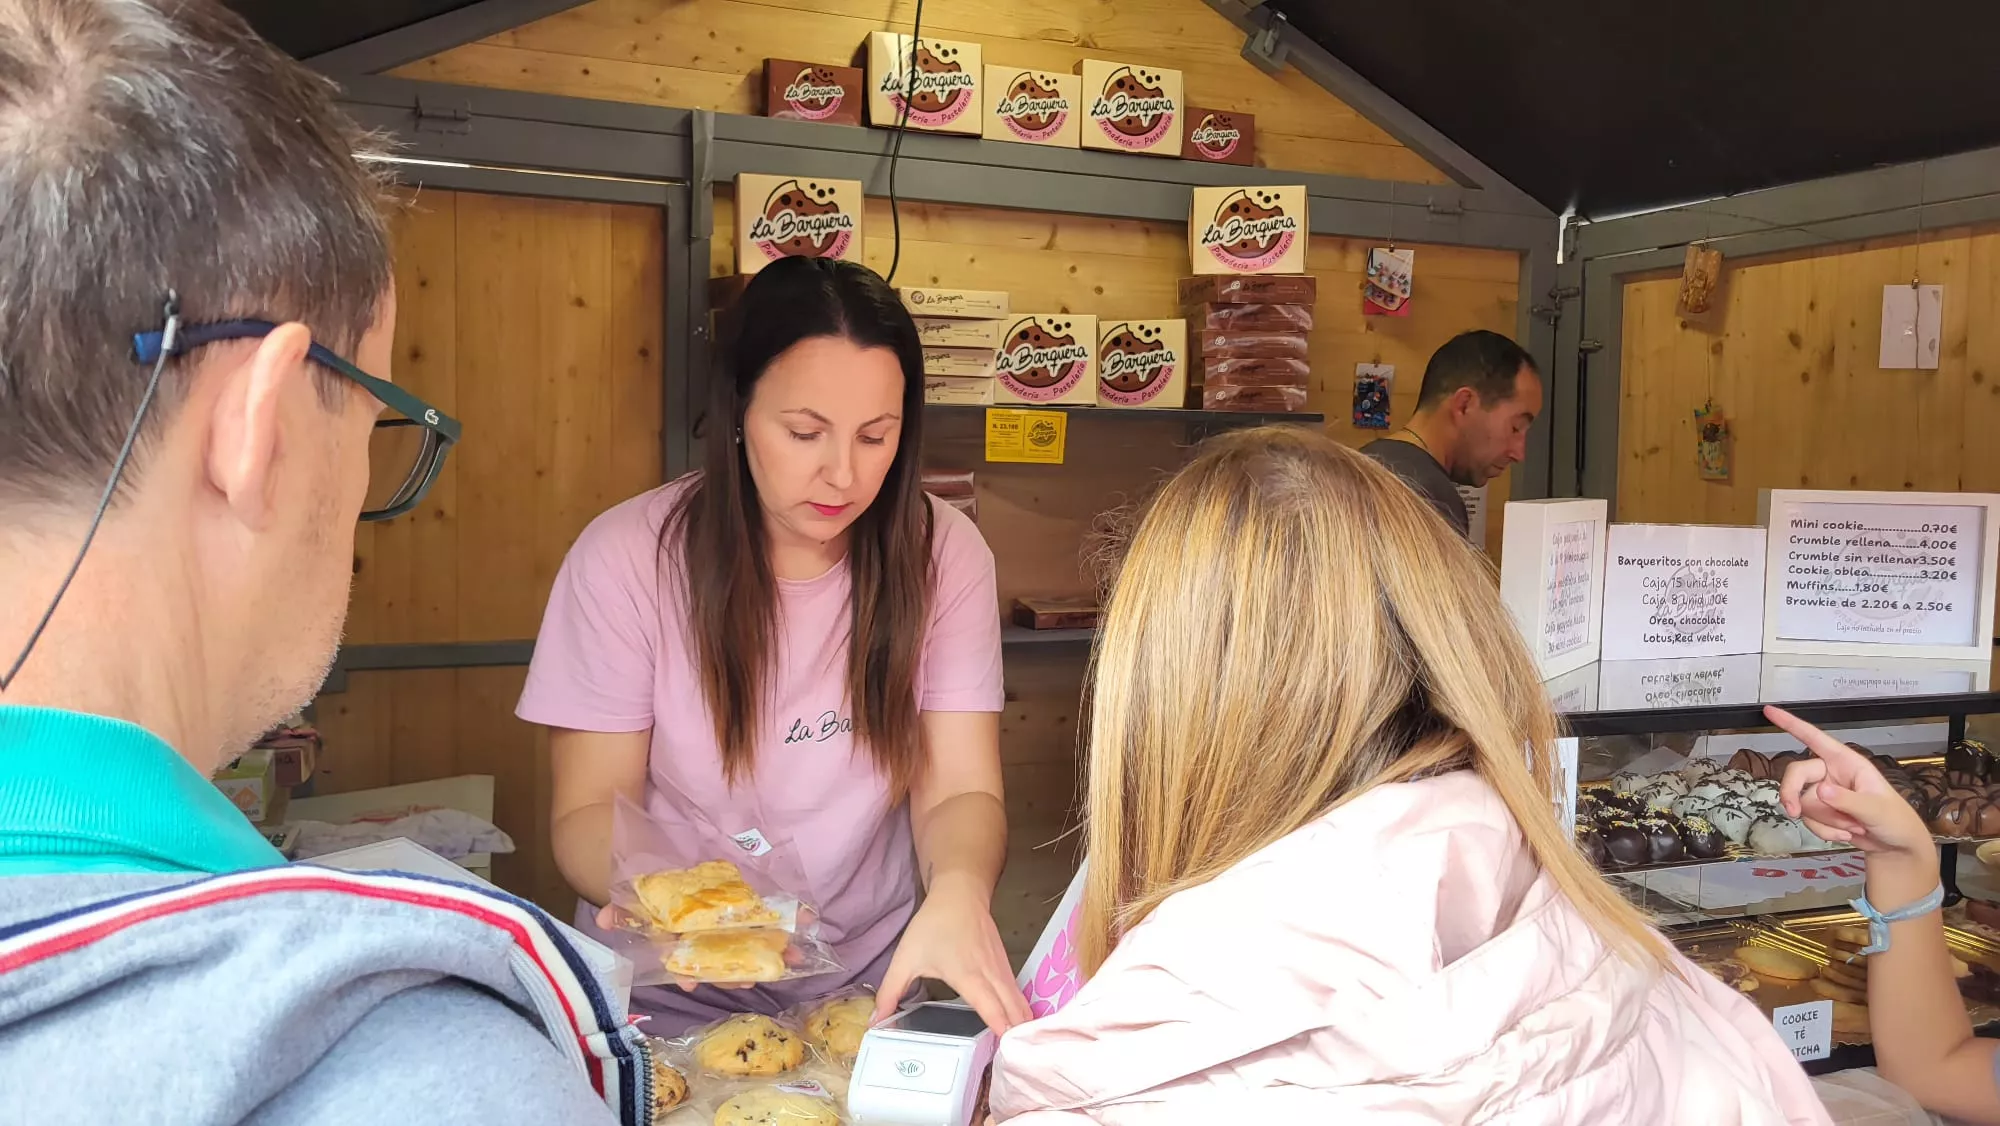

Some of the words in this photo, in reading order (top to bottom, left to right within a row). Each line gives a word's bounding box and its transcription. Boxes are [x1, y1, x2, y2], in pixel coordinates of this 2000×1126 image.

[881, 72, 903, 91] La
[905, 70, 974, 98] Barquera
[786, 87, 800, 98] La
[800, 84, 842, 102] Barquera
[891, 96, 928, 123] Pandería
[997, 96, 1015, 114] La
[1016, 94, 1068, 118] Barquera
[1091, 98, 1111, 117] La
[1112, 95, 1174, 124] Barquera
[1192, 130, 1204, 141] La
[750, 217, 775, 239] La
[776, 213, 853, 242] Barquera
[1202, 225, 1223, 244] La
[1225, 217, 1296, 243] Barquera
[996, 352, 1014, 370] La
[1014, 346, 1088, 372] Barquera
[1107, 351, 1176, 378] Barquera
[1790, 519, 1818, 529] Mini
[1789, 535, 1841, 545] Crumble
[1618, 555, 1682, 568] Barqueritos
[1705, 557, 1749, 567] chocolate
[1788, 551, 1840, 562] Crumble
[1844, 553, 1863, 562] sin
[1788, 565, 1830, 576] Cookie
[1642, 577, 1667, 591] Caja
[1671, 577, 1682, 588] 15
[1686, 577, 1708, 588] unid
[1711, 578, 1729, 588] 18€
[1642, 594, 1667, 609] Caja
[1671, 594, 1678, 604] 8
[1786, 596, 1837, 607] Browkie
[1841, 598, 1857, 608] de
[1862, 599, 1899, 610] 2.20€
[1903, 602, 1911, 610] a
[1916, 602, 1953, 612] 2.50€
[1649, 615, 1676, 627] Oreo,
[1680, 615, 1726, 624] chocolate
[1696, 632, 1726, 643] velvet,
[784, 718, 814, 744] La
[1782, 1010, 1819, 1025] COOKIE
[1794, 1026, 1806, 1040] TÉ
